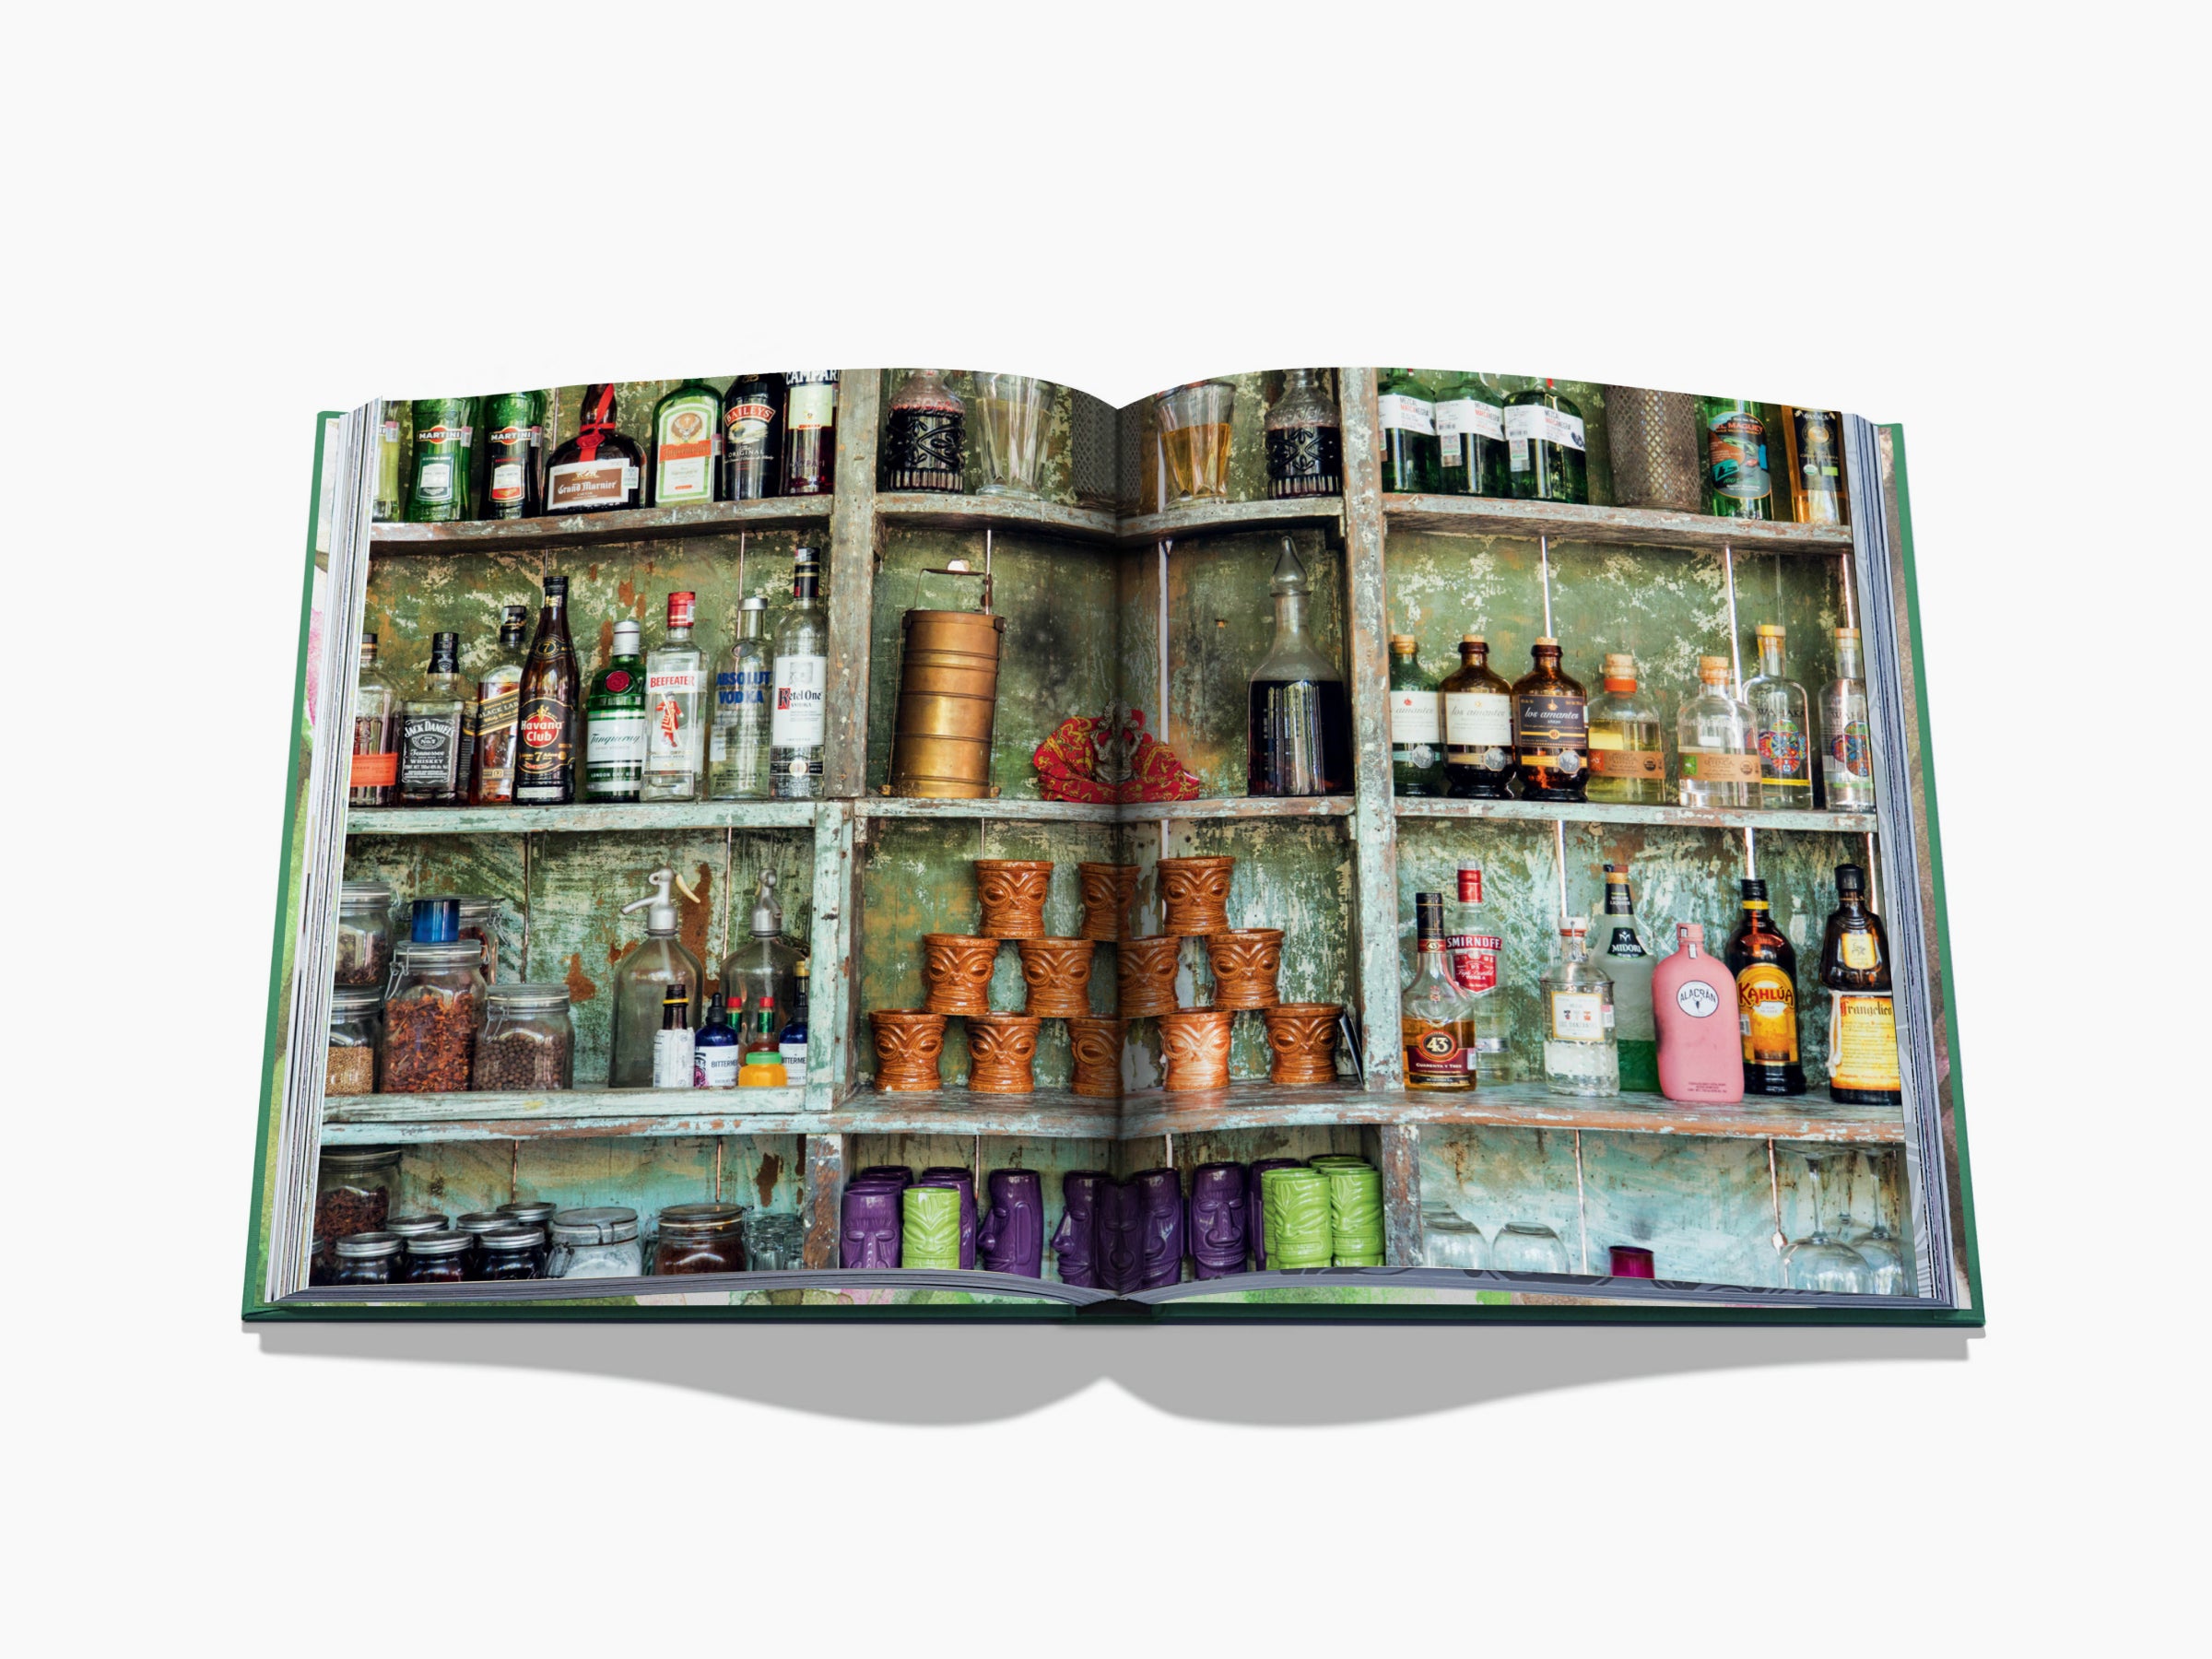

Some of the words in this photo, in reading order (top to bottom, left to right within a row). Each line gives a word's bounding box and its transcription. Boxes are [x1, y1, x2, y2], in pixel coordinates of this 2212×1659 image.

[725, 405, 772, 422] BAILEYS
[1727, 421, 1763, 432] MAGUEY
[418, 430, 461, 441] MARTINI
[490, 431, 532, 441] MARTINI
[728, 449, 765, 458] ORIGINAL
[558, 482, 581, 495] Grand
[582, 479, 618, 492] Marnier
[650, 676, 695, 688] BEEFEATER
[716, 671, 771, 686] ABSOLUT
[718, 689, 764, 704] VODKA
[777, 688, 804, 711] Ketel
[805, 689, 821, 700] One
[1452, 706, 1465, 716] los
[1524, 707, 1538, 718] los
[1539, 710, 1579, 720] amantes
[404, 724, 424, 738] JACK
[521, 720, 563, 731] Havana
[526, 731, 553, 742] Club
[1446, 936, 1500, 948] SMIRNOFF
[1611, 944, 1641, 953] MIDORI
[1680, 988, 1717, 1004] ALACRÁN
[1738, 982, 1794, 1006] KAHLÚA
[1426, 1037, 1449, 1053] 43
